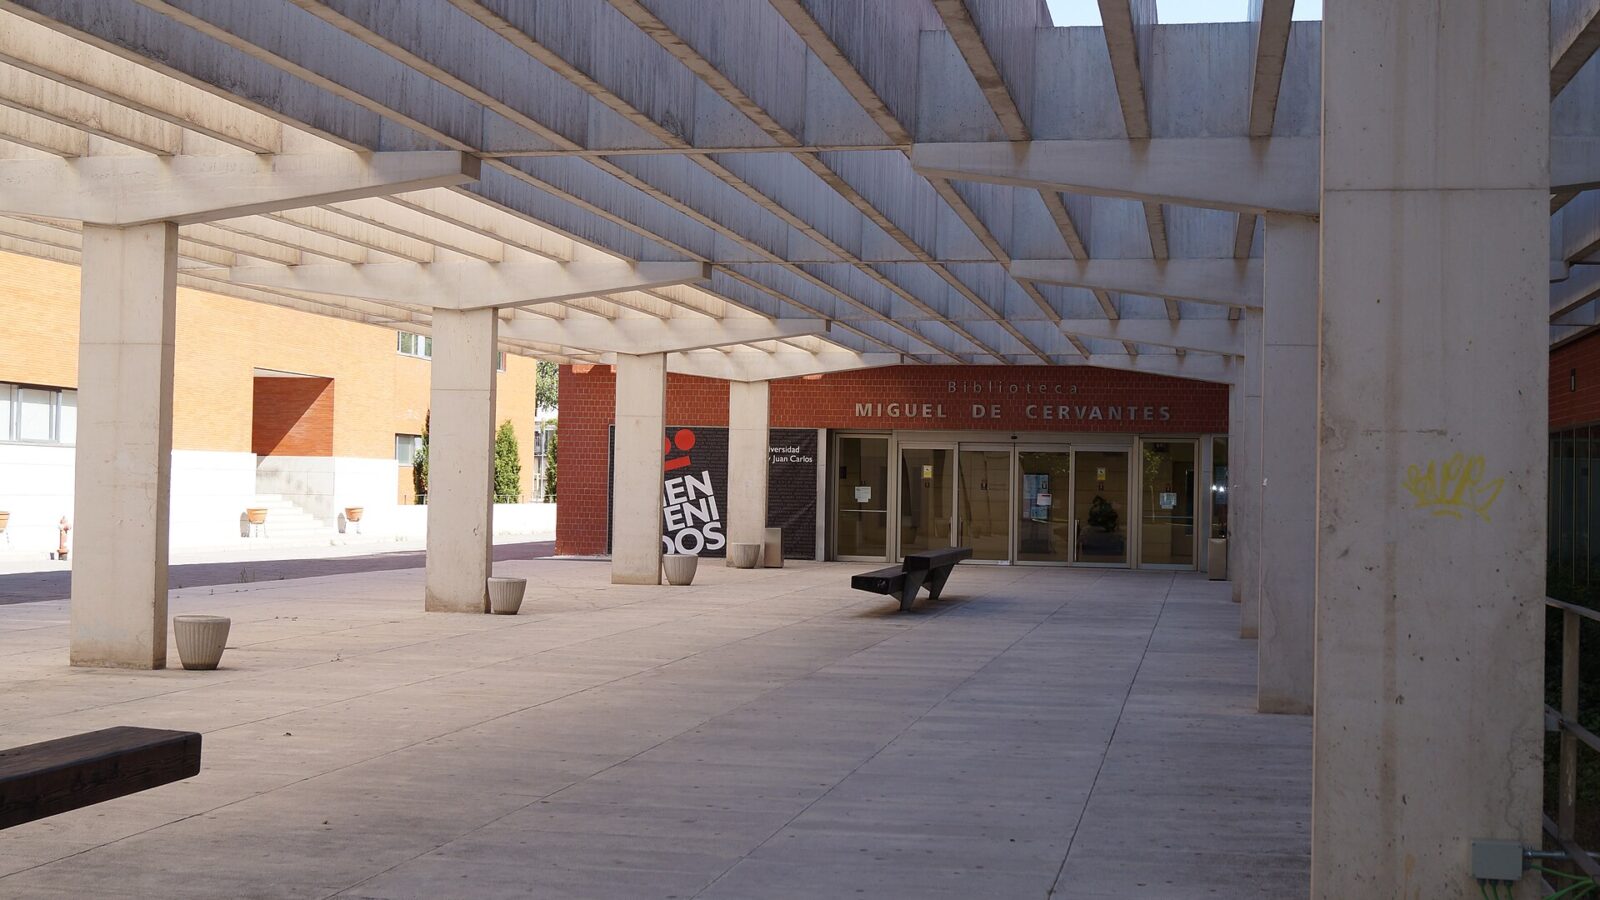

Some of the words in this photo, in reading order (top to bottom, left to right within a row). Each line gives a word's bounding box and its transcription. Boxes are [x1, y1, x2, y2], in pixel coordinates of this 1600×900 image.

[948, 381, 1077, 394] Biblioteca
[855, 403, 947, 418] MIGUEL
[972, 404, 1002, 419] DE
[1025, 404, 1170, 421] CERVANTES
[772, 454, 788, 464] Juan
[790, 454, 813, 463] Carlos
[664, 470, 714, 507] EN
